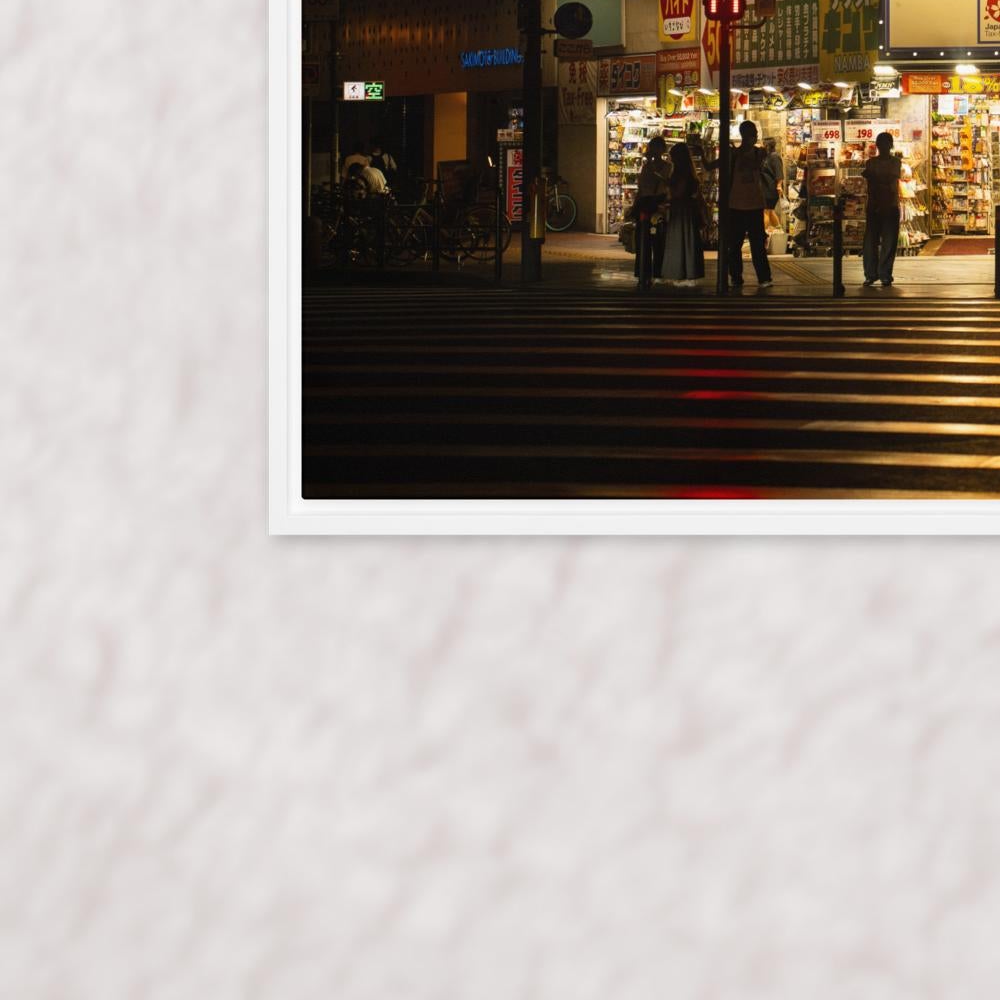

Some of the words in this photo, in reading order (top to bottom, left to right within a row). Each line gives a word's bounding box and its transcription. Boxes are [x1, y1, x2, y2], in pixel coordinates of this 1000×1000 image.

[834, 56, 870, 73] NAMBA
[365, 82, 384, 100] 空
[857, 128, 873, 139] 198
